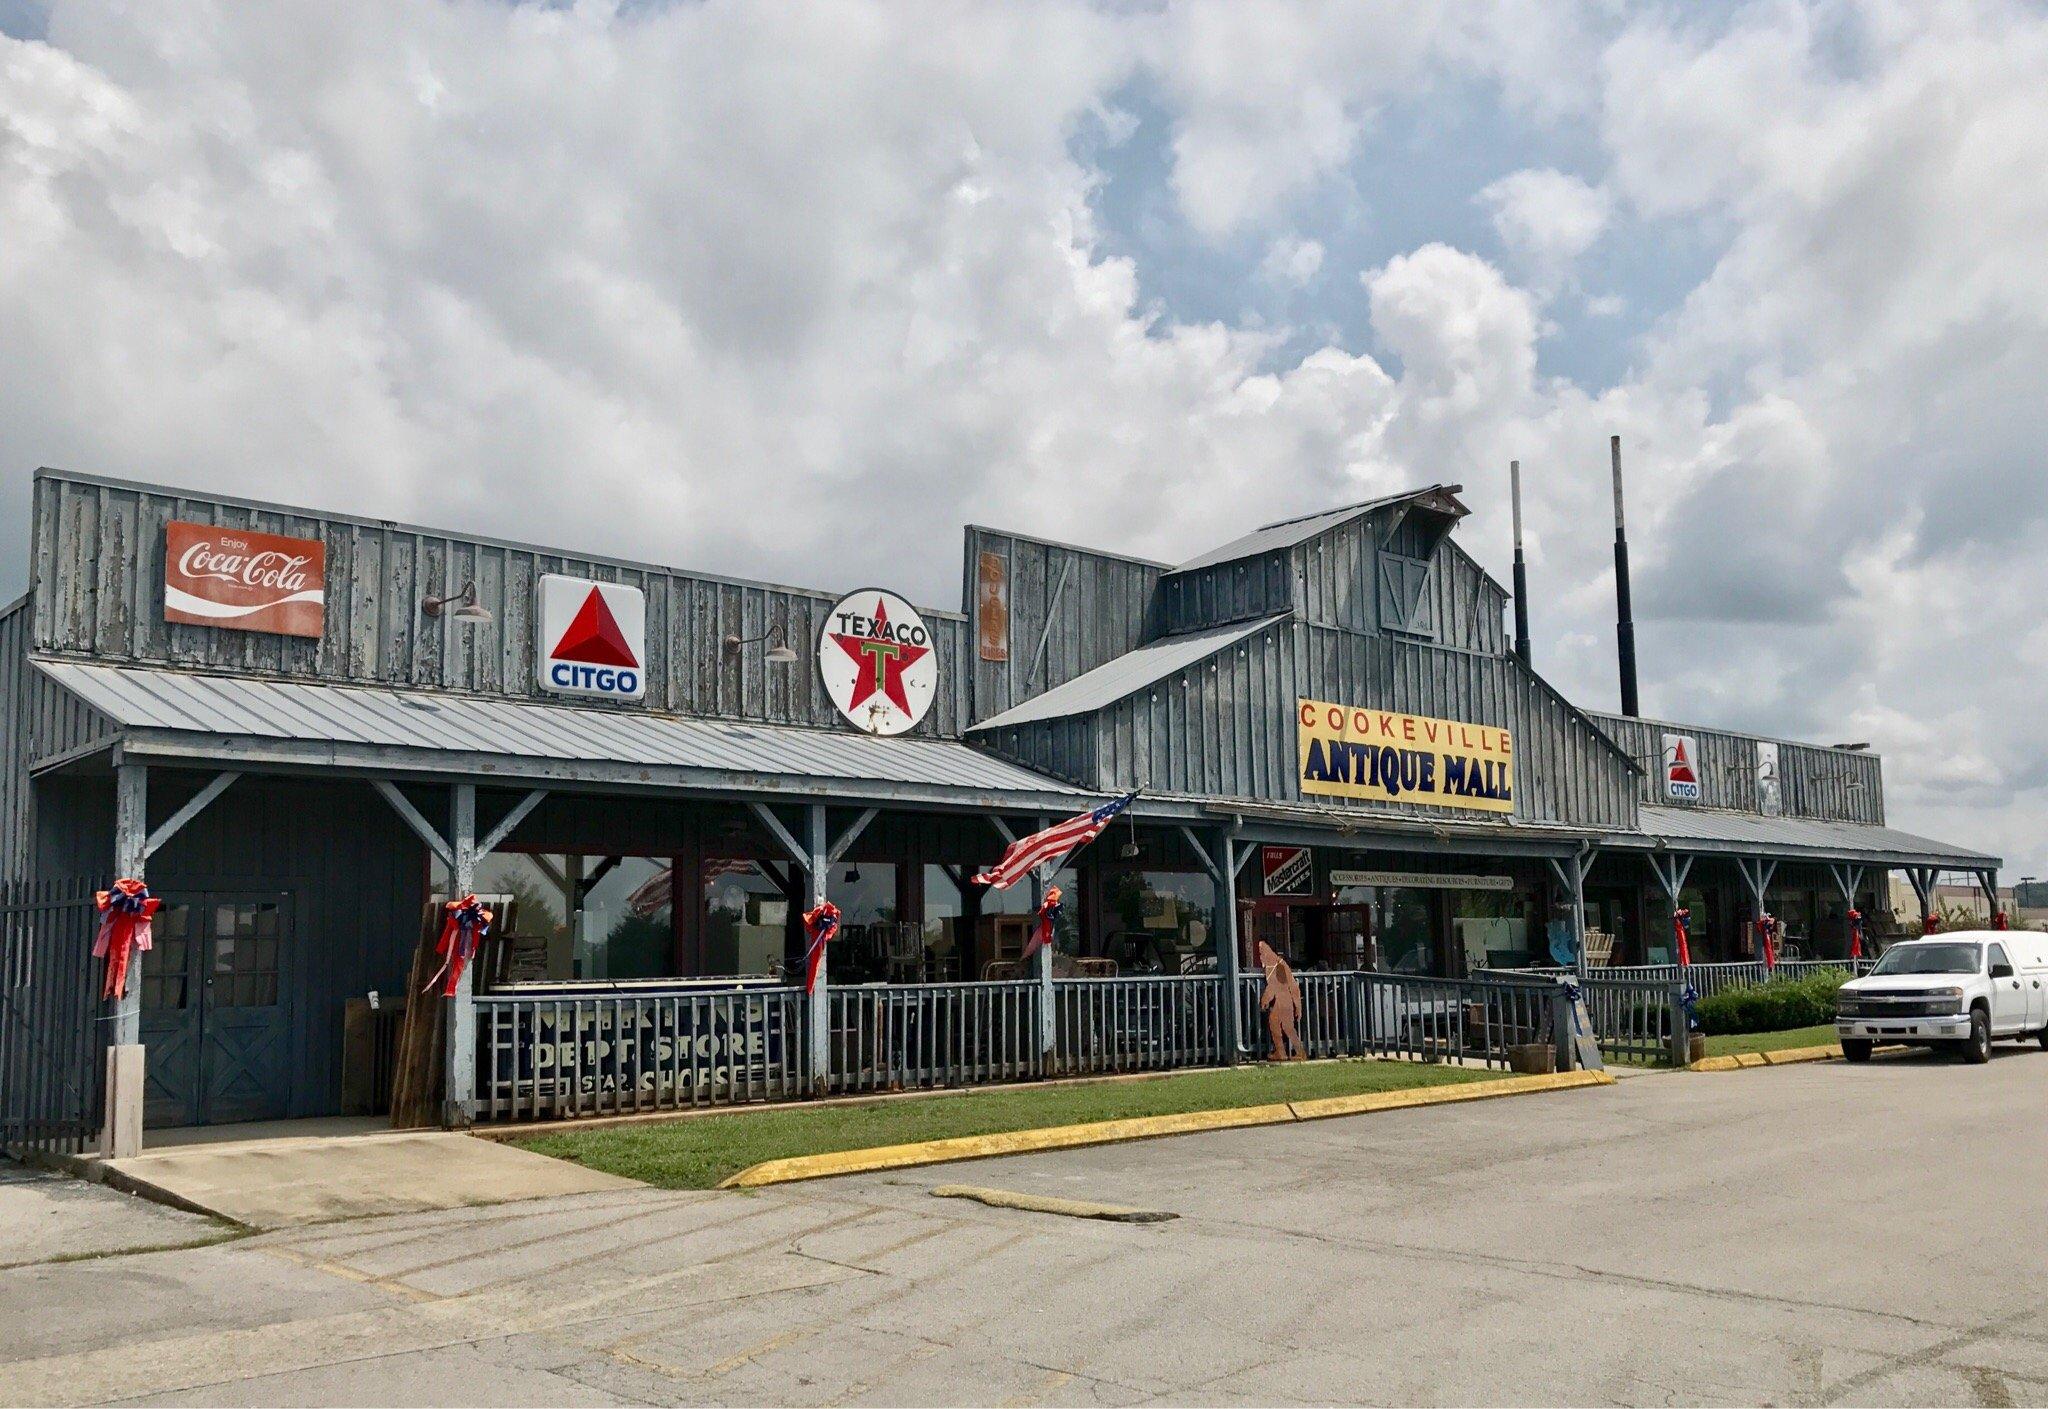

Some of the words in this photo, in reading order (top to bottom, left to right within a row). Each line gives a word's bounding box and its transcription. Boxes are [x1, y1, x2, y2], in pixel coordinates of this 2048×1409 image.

[220, 536, 248, 551] Enjoy
[178, 542, 313, 591] Coca-Cola
[836, 611, 927, 646] TEXACO
[551, 663, 638, 693] CITGO
[1300, 704, 1511, 754] COOKEVILLE
[1303, 737, 1436, 796] ANTIQUE
[1442, 754, 1512, 801] MALL
[1670, 783, 1697, 797] CITGO
[1266, 850, 1311, 893] Mastercraft
[650, 1030, 764, 1062] STORE
